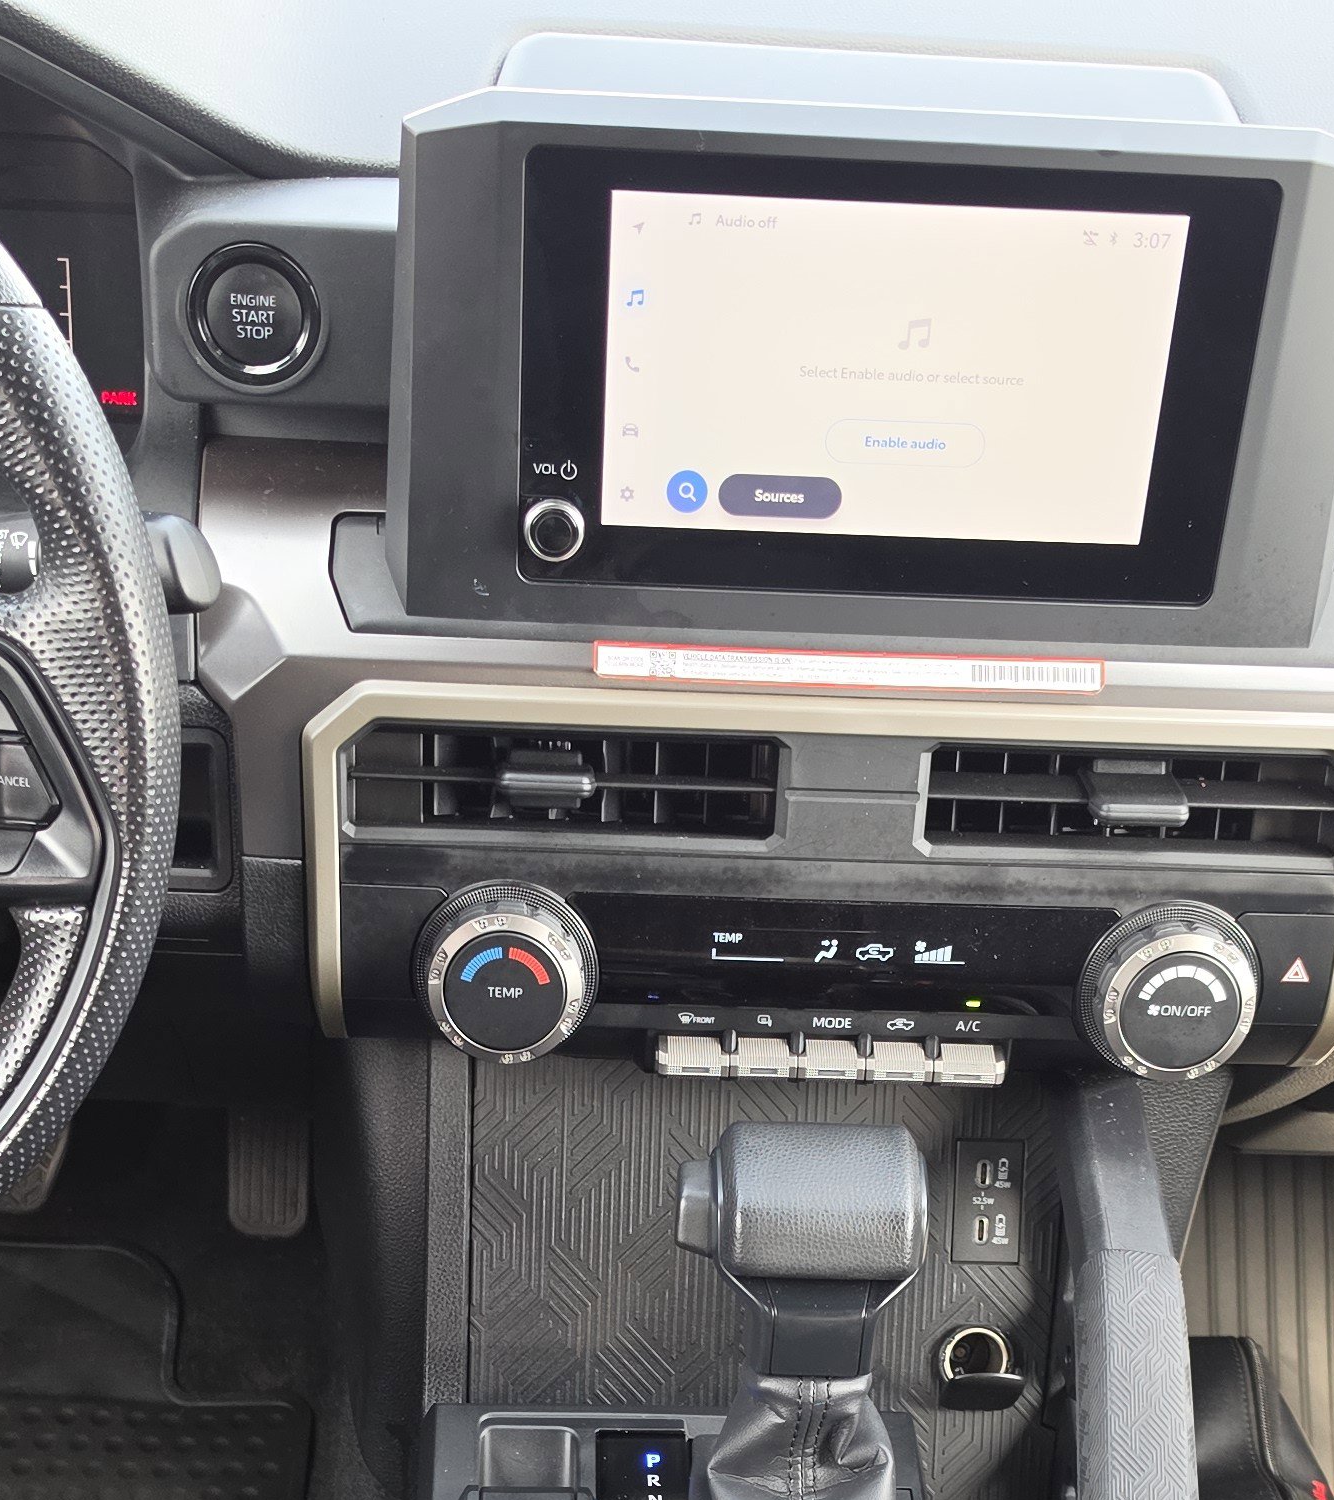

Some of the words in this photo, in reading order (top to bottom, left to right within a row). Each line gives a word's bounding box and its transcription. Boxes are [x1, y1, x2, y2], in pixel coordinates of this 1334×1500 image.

[715, 214, 755, 228] Audio
[758, 216, 778, 229] off
[1133, 231, 1171, 249] 3:07
[230, 293, 277, 308] ENGINE
[231, 309, 275, 324] START
[236, 325, 274, 340] STOP
[799, 366, 838, 379] Select
[840, 367, 885, 381] Enable
[887, 369, 924, 383] audio
[926, 373, 940, 383] or
[943, 371, 981, 385] select
[983, 375, 1024, 387] source
[864, 435, 908, 449] Enable
[910, 438, 946, 451] audio
[533, 463, 557, 475] VOL
[754, 489, 805, 504] Sources
[712, 932, 743, 944] TEMP
[487, 986, 524, 999] TEMP
[1160, 1004, 1212, 1018] ON/OFF
[692, 1015, 715, 1025] FRONT
[812, 1016, 852, 1029] MODE
[955, 1020, 981, 1033] A/C
[994, 1180, 1012, 1189] 45W
[972, 1196, 995, 1205] 52.5W
[991, 1236, 1009, 1245] 45W
[646, 1453, 661, 1468] P
[647, 1474, 662, 1487] R
